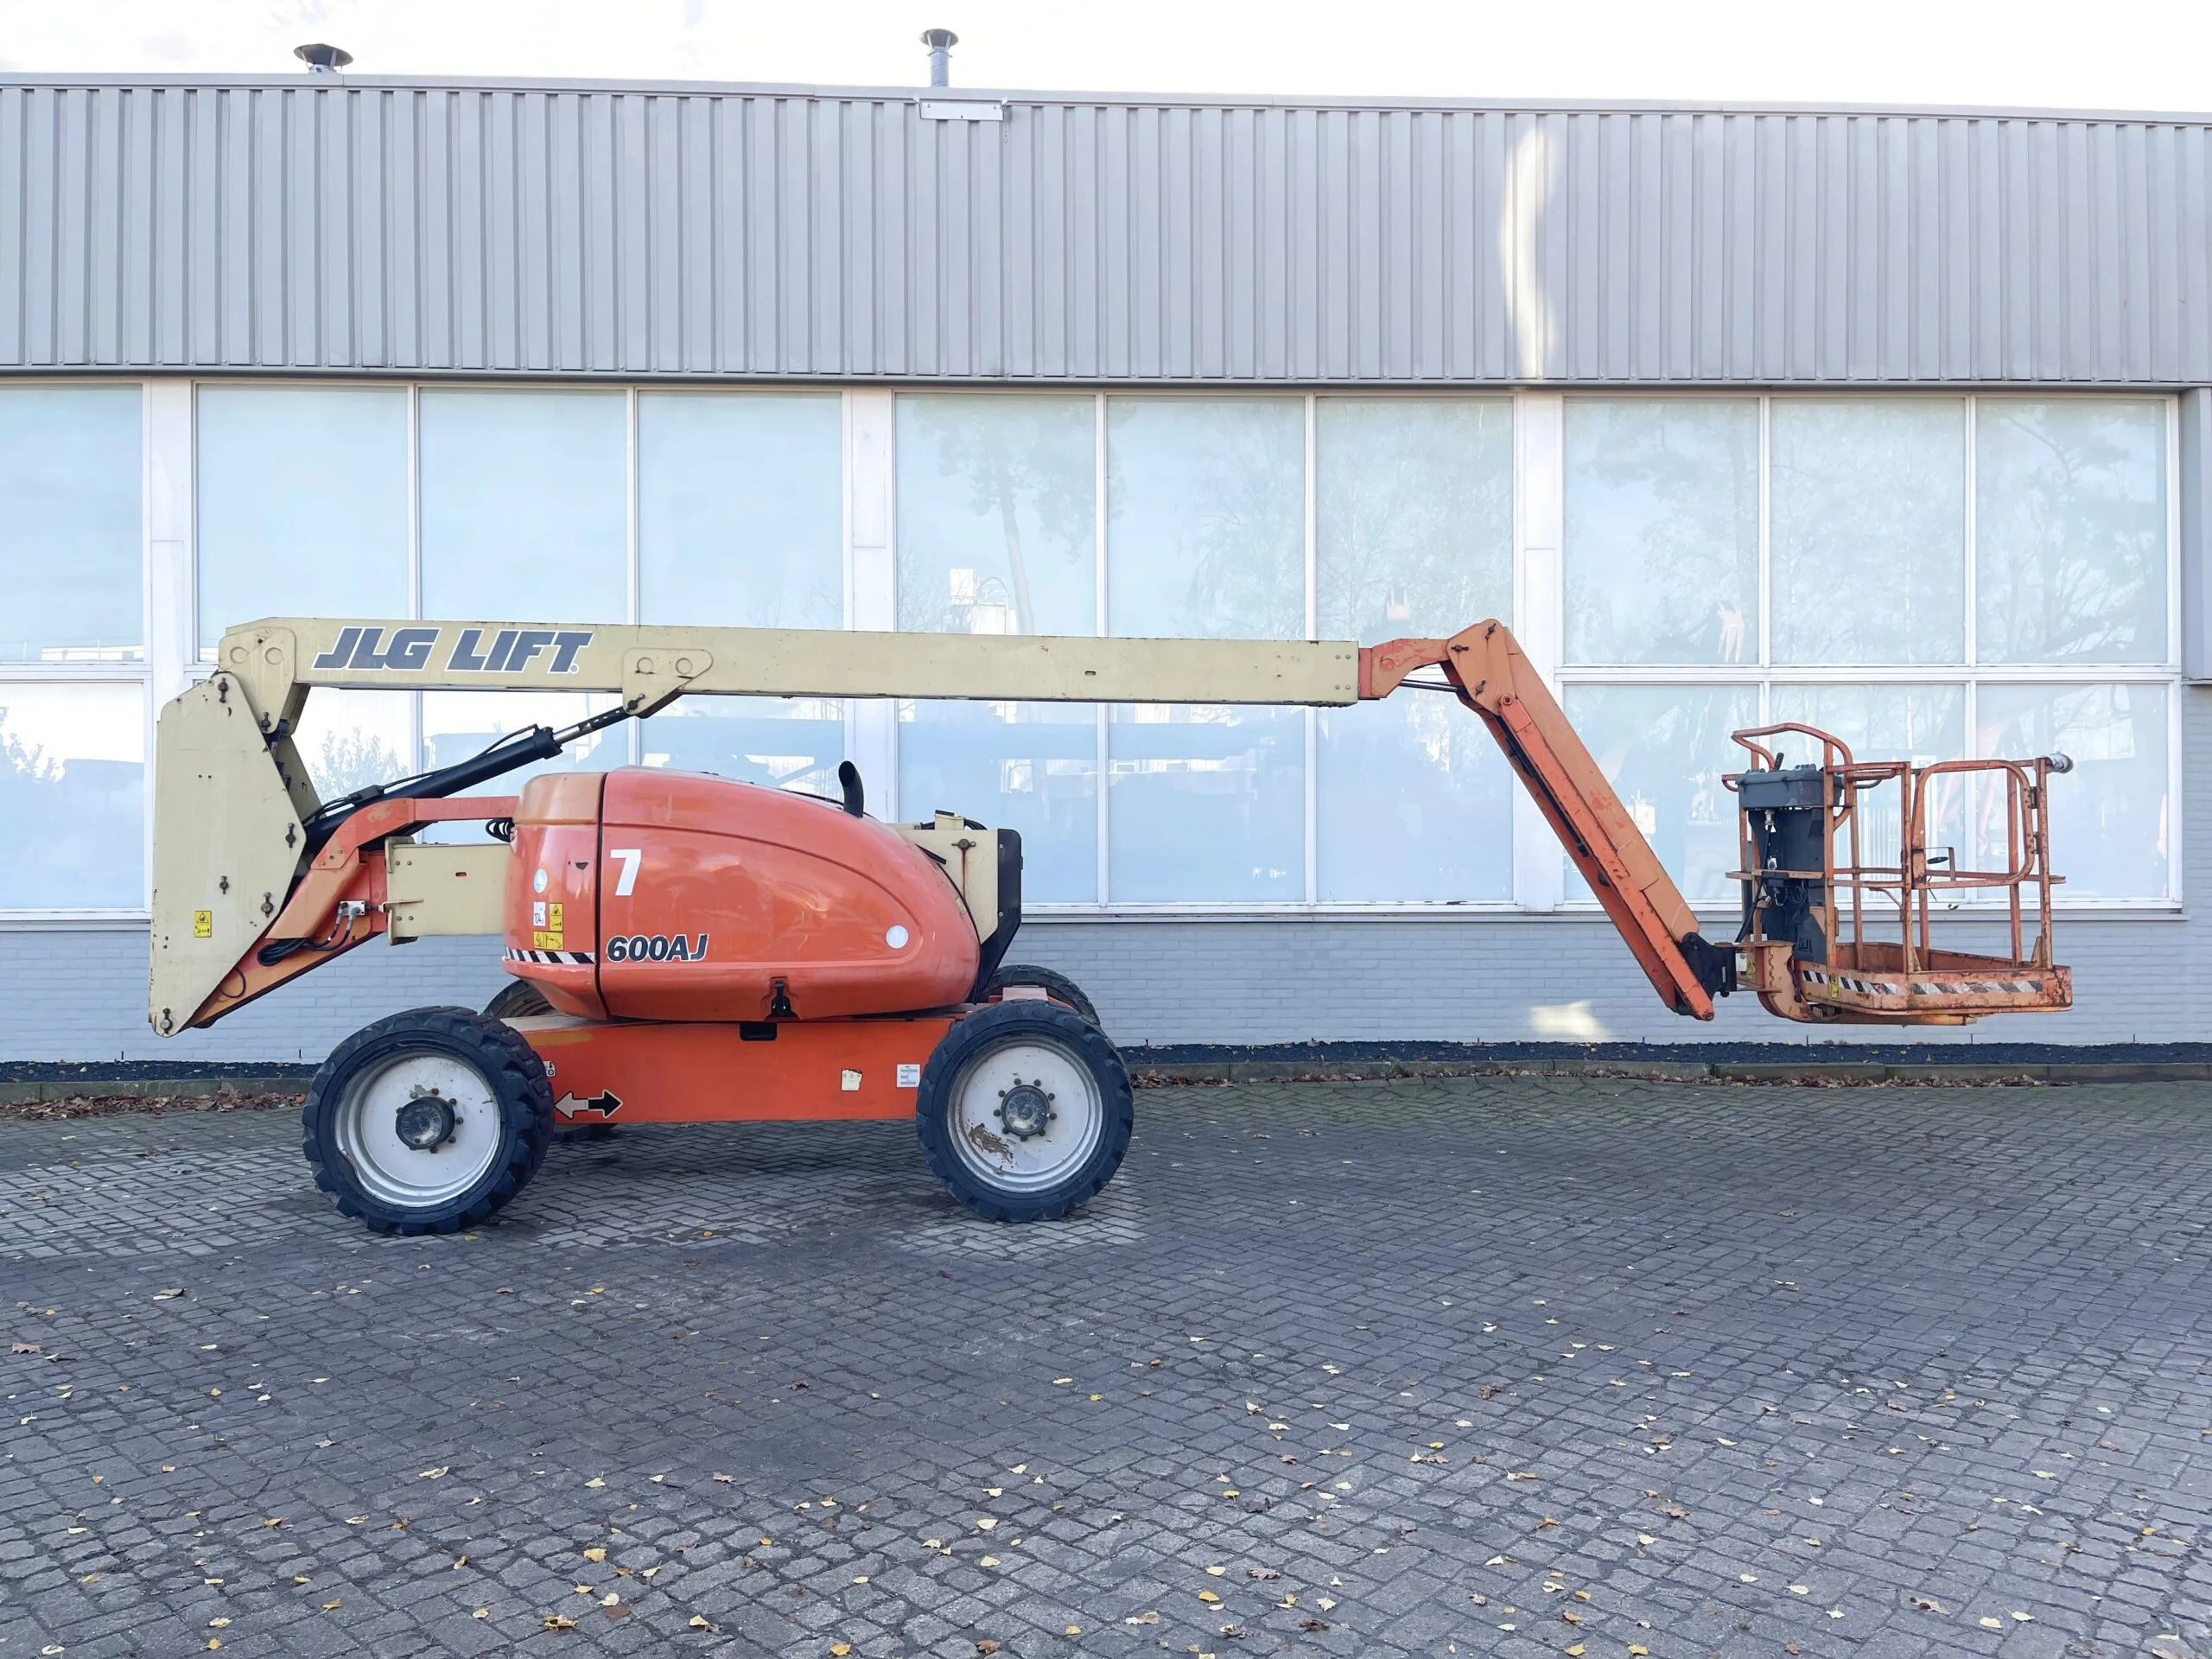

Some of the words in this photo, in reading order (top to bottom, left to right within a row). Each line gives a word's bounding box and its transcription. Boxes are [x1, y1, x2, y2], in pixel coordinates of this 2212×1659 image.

[311, 626, 442, 671] JLG
[443, 628, 594, 674] LIFT
[610, 849, 642, 896] 7
[606, 933, 709, 963] 600AJ
